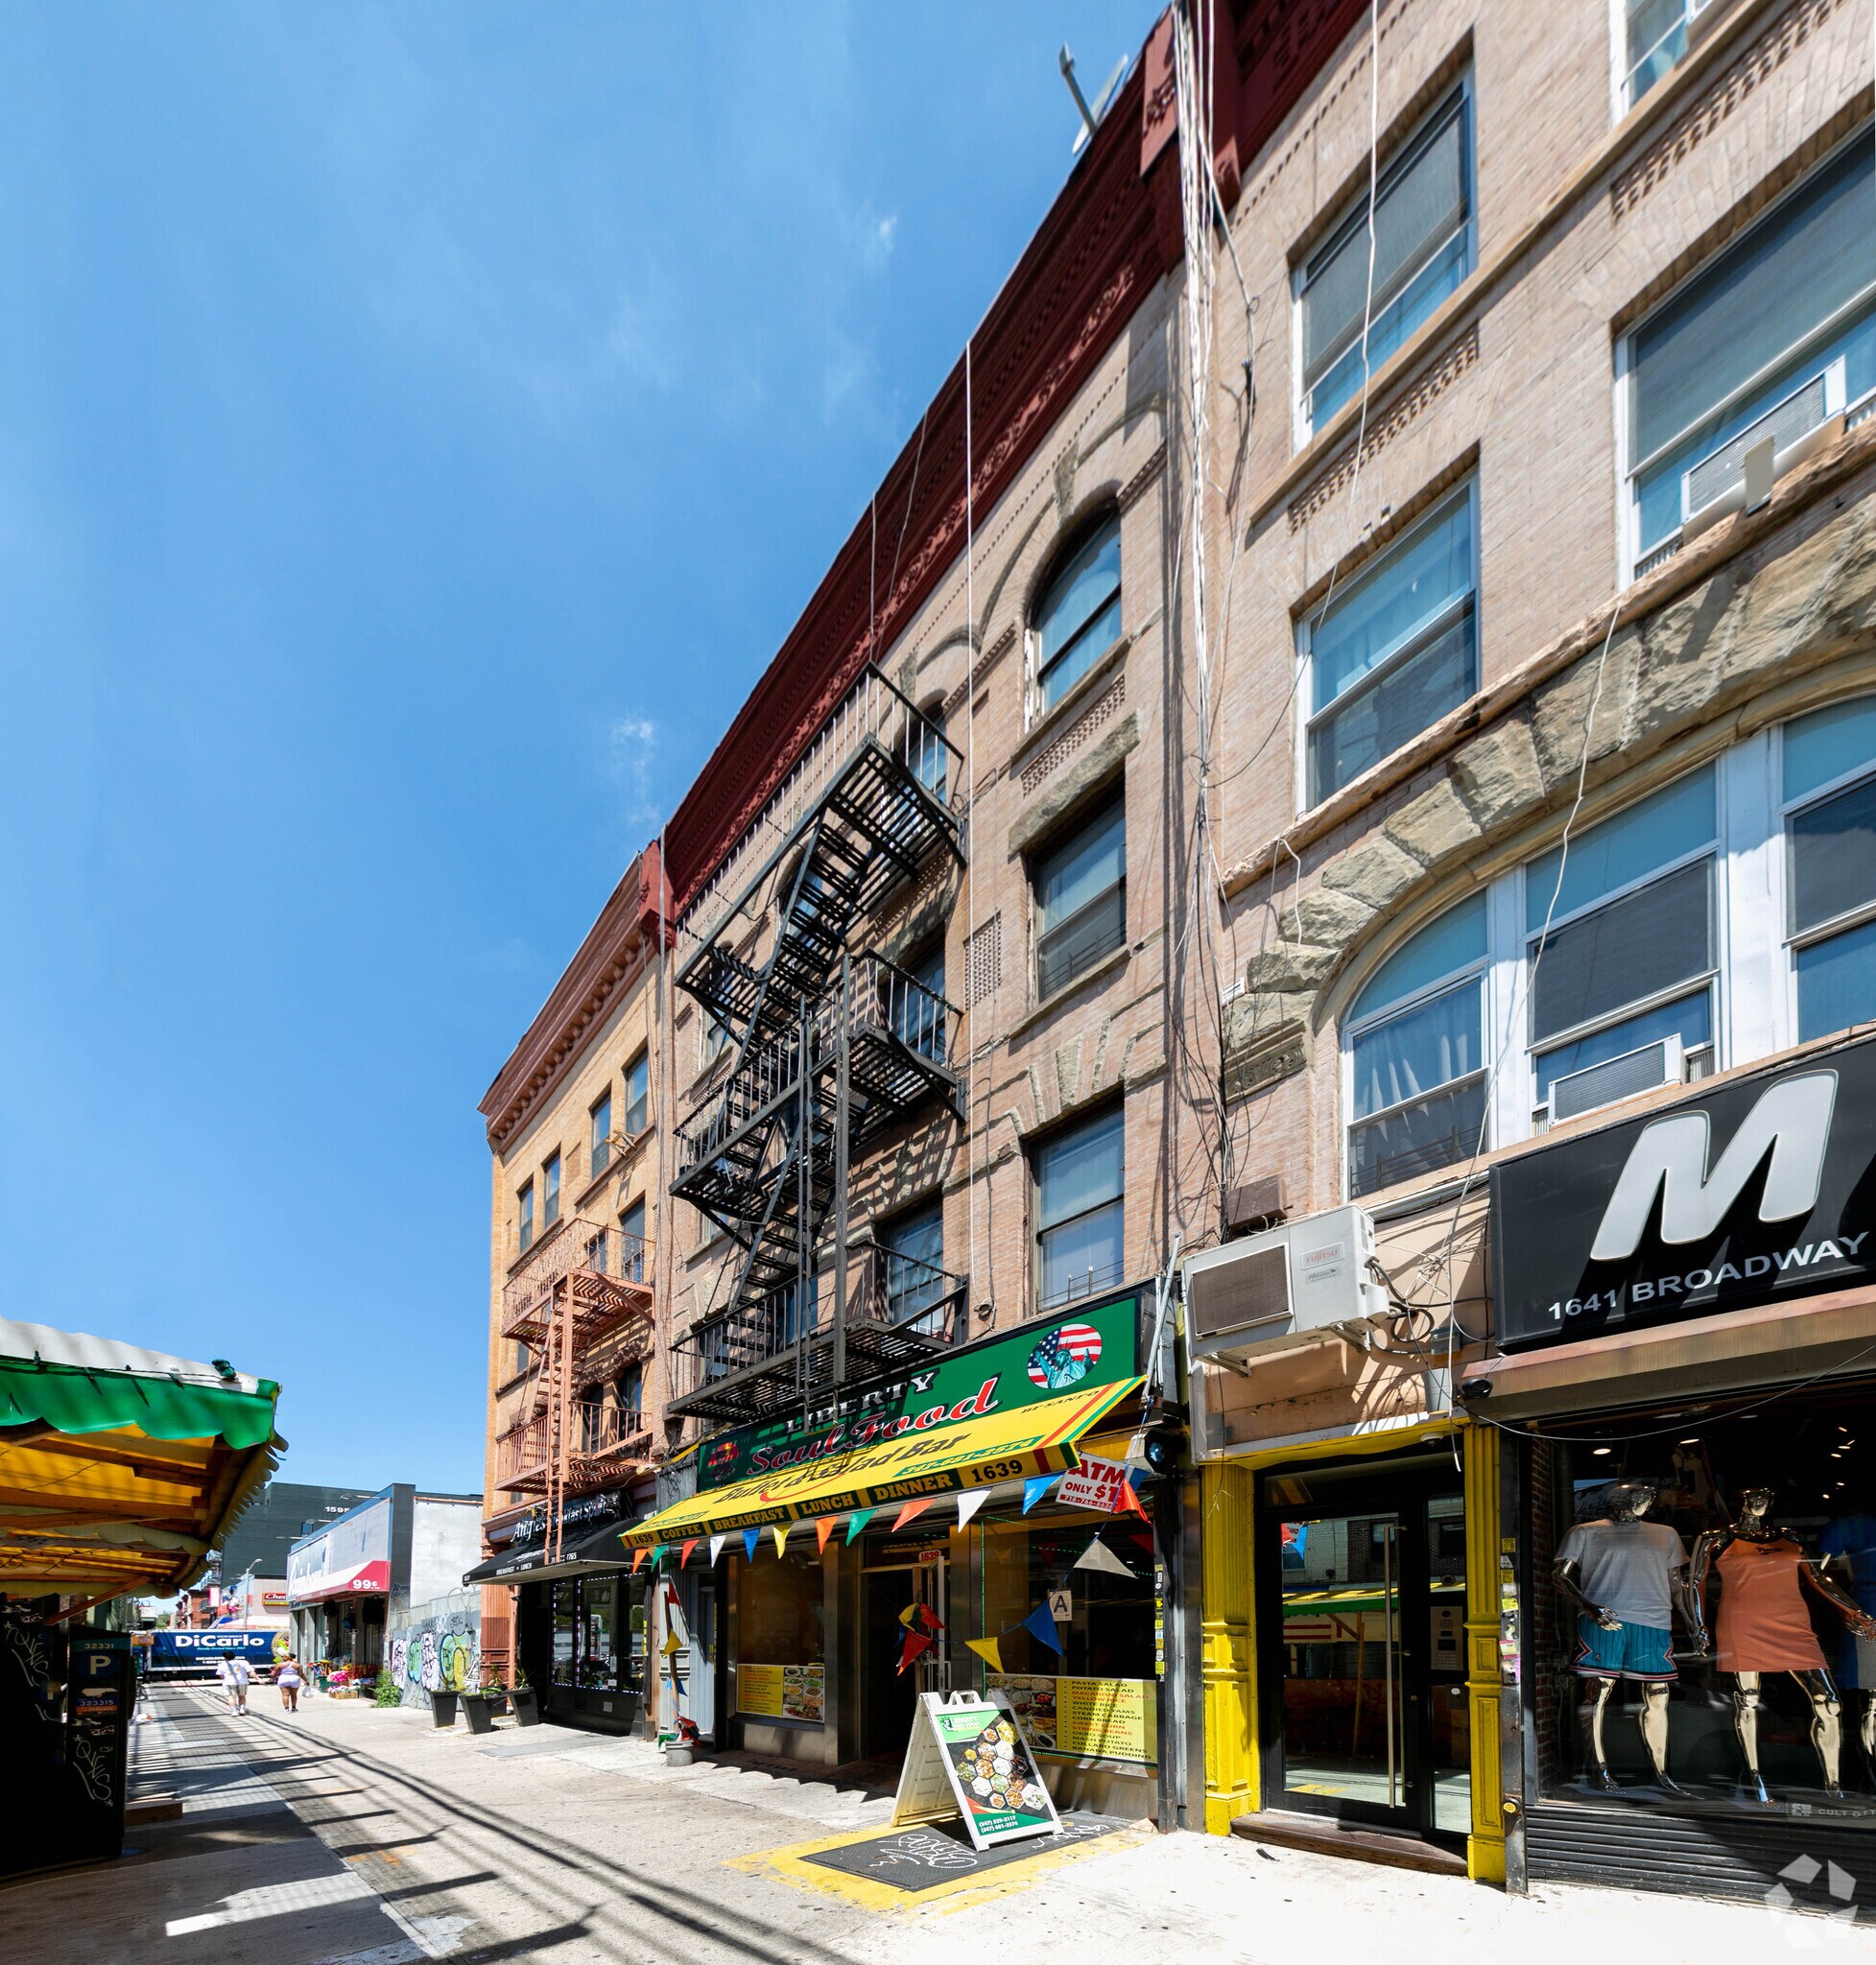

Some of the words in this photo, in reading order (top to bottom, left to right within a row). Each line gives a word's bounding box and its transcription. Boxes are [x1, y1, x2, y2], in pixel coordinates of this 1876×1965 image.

[1589, 1069, 1839, 1261] M
[1305, 1249, 1338, 1264] FUJITSU
[1548, 1289, 1617, 1320] 1641
[1633, 1231, 1869, 1303] BROADWAY
[786, 1371, 938, 1433] LIBERTY
[746, 1424, 845, 1476] Soul
[843, 1376, 1001, 1450] Food
[893, 1432, 971, 1462] Bar
[1067, 1457, 1126, 1486] ATM
[1064, 1481, 1103, 1496] ONLY
[633, 1534, 653, 1546] 1639
[661, 1524, 701, 1540] COFFEE
[713, 1506, 785, 1531] BREAKFAST
[799, 1495, 855, 1516] LUNCH
[873, 1474, 954, 1502] DINNER
[971, 1459, 1023, 1483] 1639
[920, 1551, 939, 1562] 1639
[1053, 1595, 1068, 1613] A
[175, 1634, 265, 1647] DiCarlo
[90, 1655, 111, 1675] P
[1071, 1740, 1111, 1749] COLLARD
[1112, 1744, 1148, 1754] GREENS
[1098, 1737, 1132, 1745] POTATO
[1108, 1749, 1152, 1760] PUDDING
